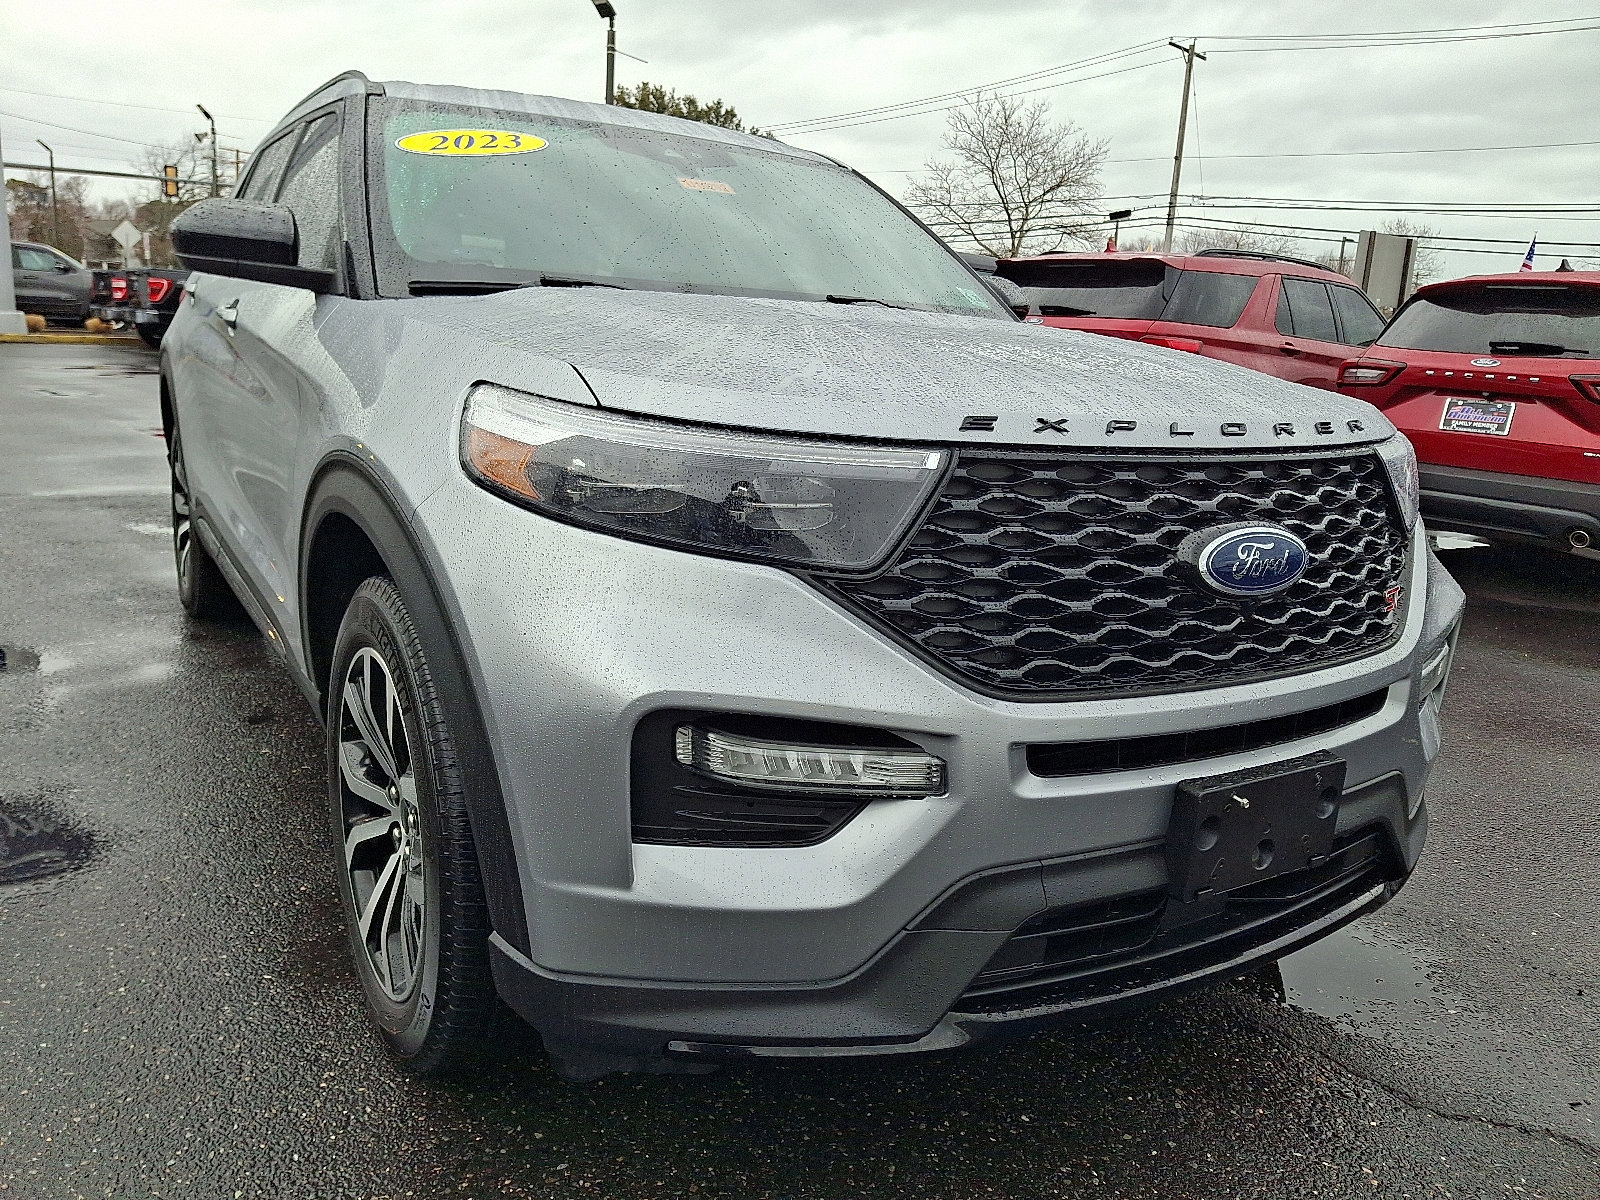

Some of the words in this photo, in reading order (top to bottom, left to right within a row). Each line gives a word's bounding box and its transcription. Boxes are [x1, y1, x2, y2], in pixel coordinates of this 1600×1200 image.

[429, 134, 522, 150] 2023
[958, 415, 1365, 437] EXPLORER
[1232, 542, 1290, 580] Ford
